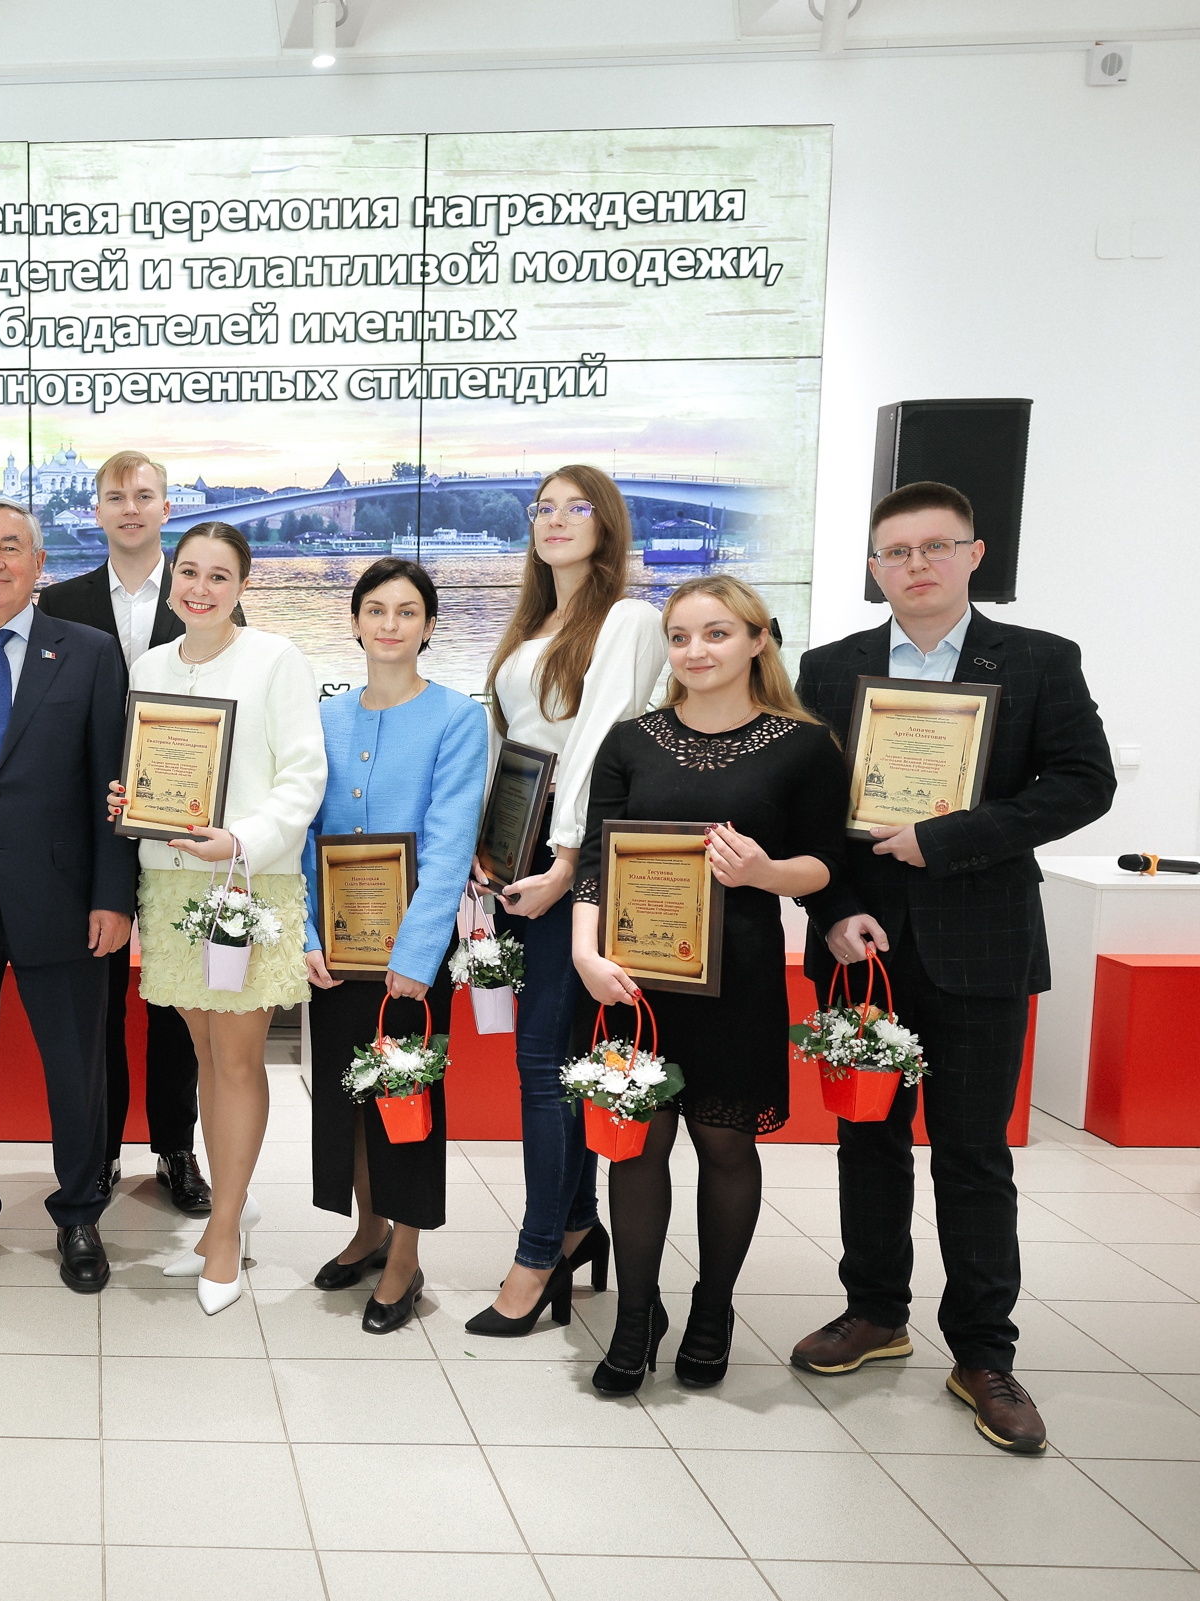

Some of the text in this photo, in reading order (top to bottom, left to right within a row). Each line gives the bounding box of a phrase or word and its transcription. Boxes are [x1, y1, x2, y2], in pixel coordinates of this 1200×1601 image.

[133, 196, 399, 243] церемония
[414, 188, 745, 235] награждения
[143, 258, 171, 290] и
[184, 242, 499, 289] талантливой
[513, 246, 783, 287] молодежи,
[293, 308, 516, 344] именных
[348, 353, 608, 404] стипендий
